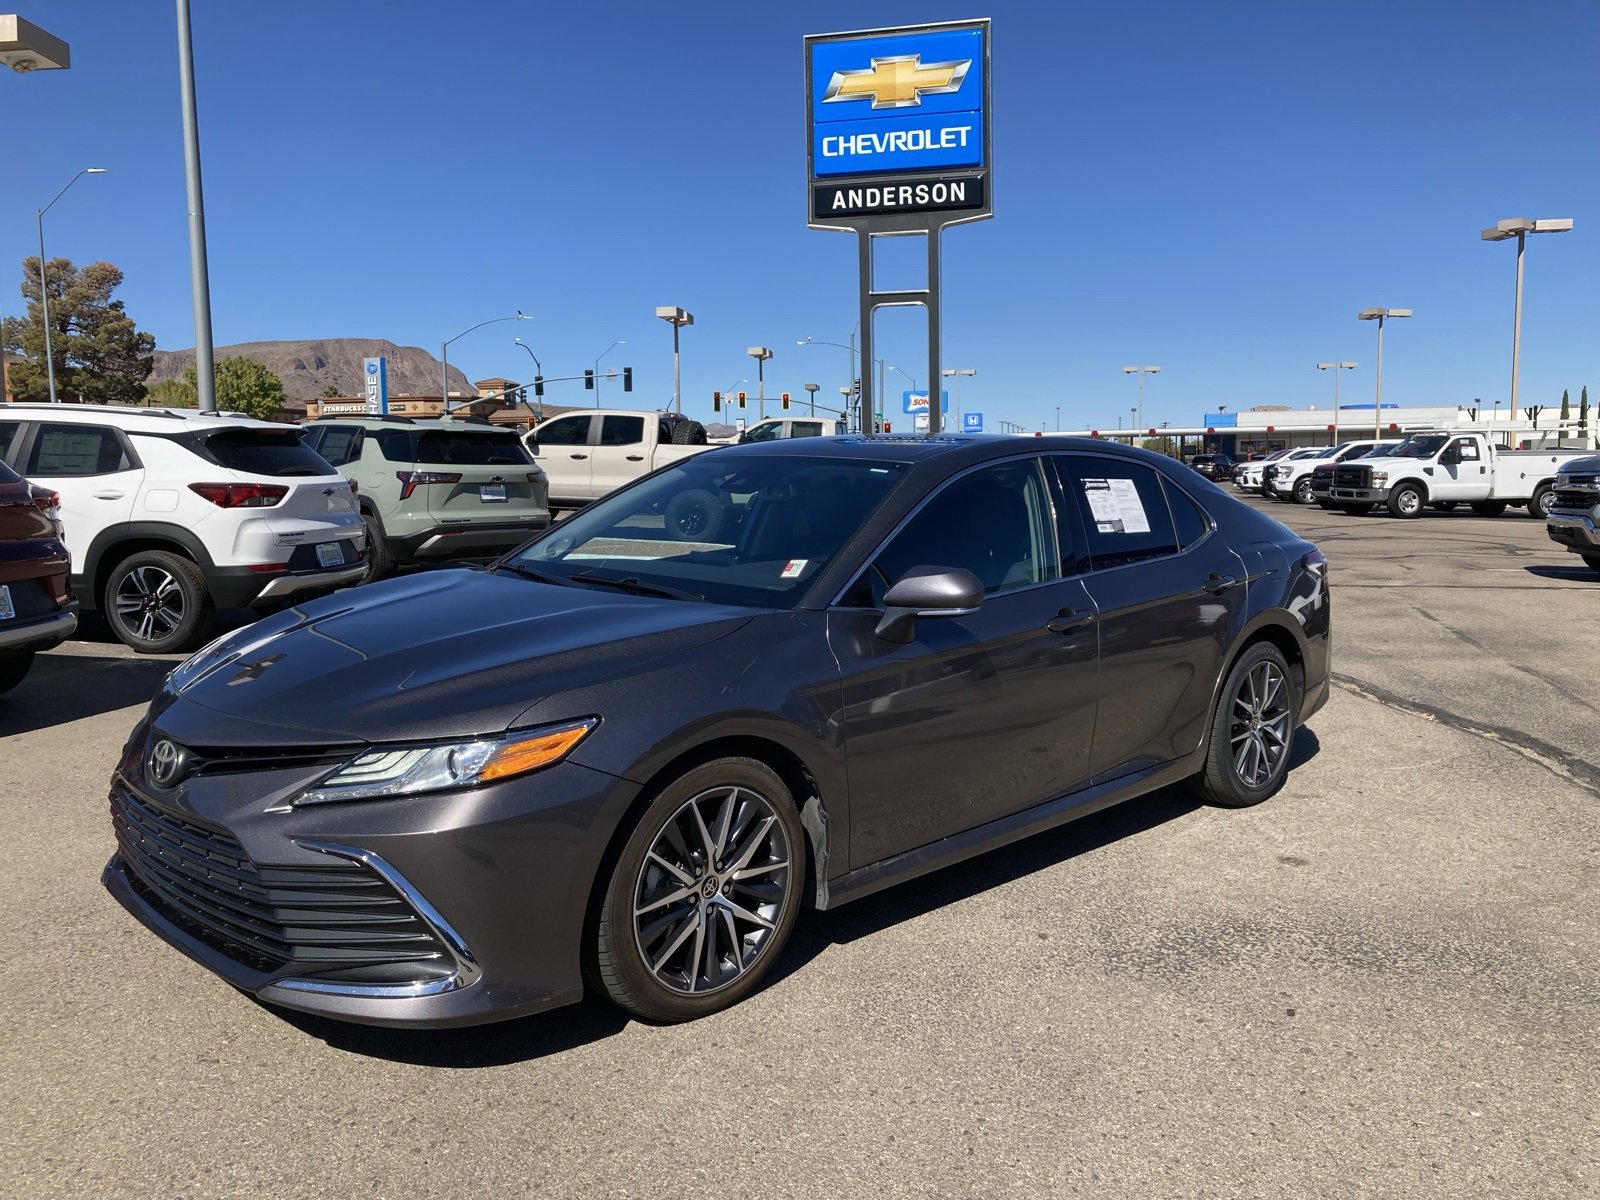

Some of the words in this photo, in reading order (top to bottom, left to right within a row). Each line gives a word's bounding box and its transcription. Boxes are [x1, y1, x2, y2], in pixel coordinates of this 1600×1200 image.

[822, 126, 972, 157] CHEVROLET
[832, 182, 965, 210] ANDERSON
[323, 405, 361, 413] STARBUCKS
[367, 376, 378, 415] HASE
[912, 398, 929, 406] SON
